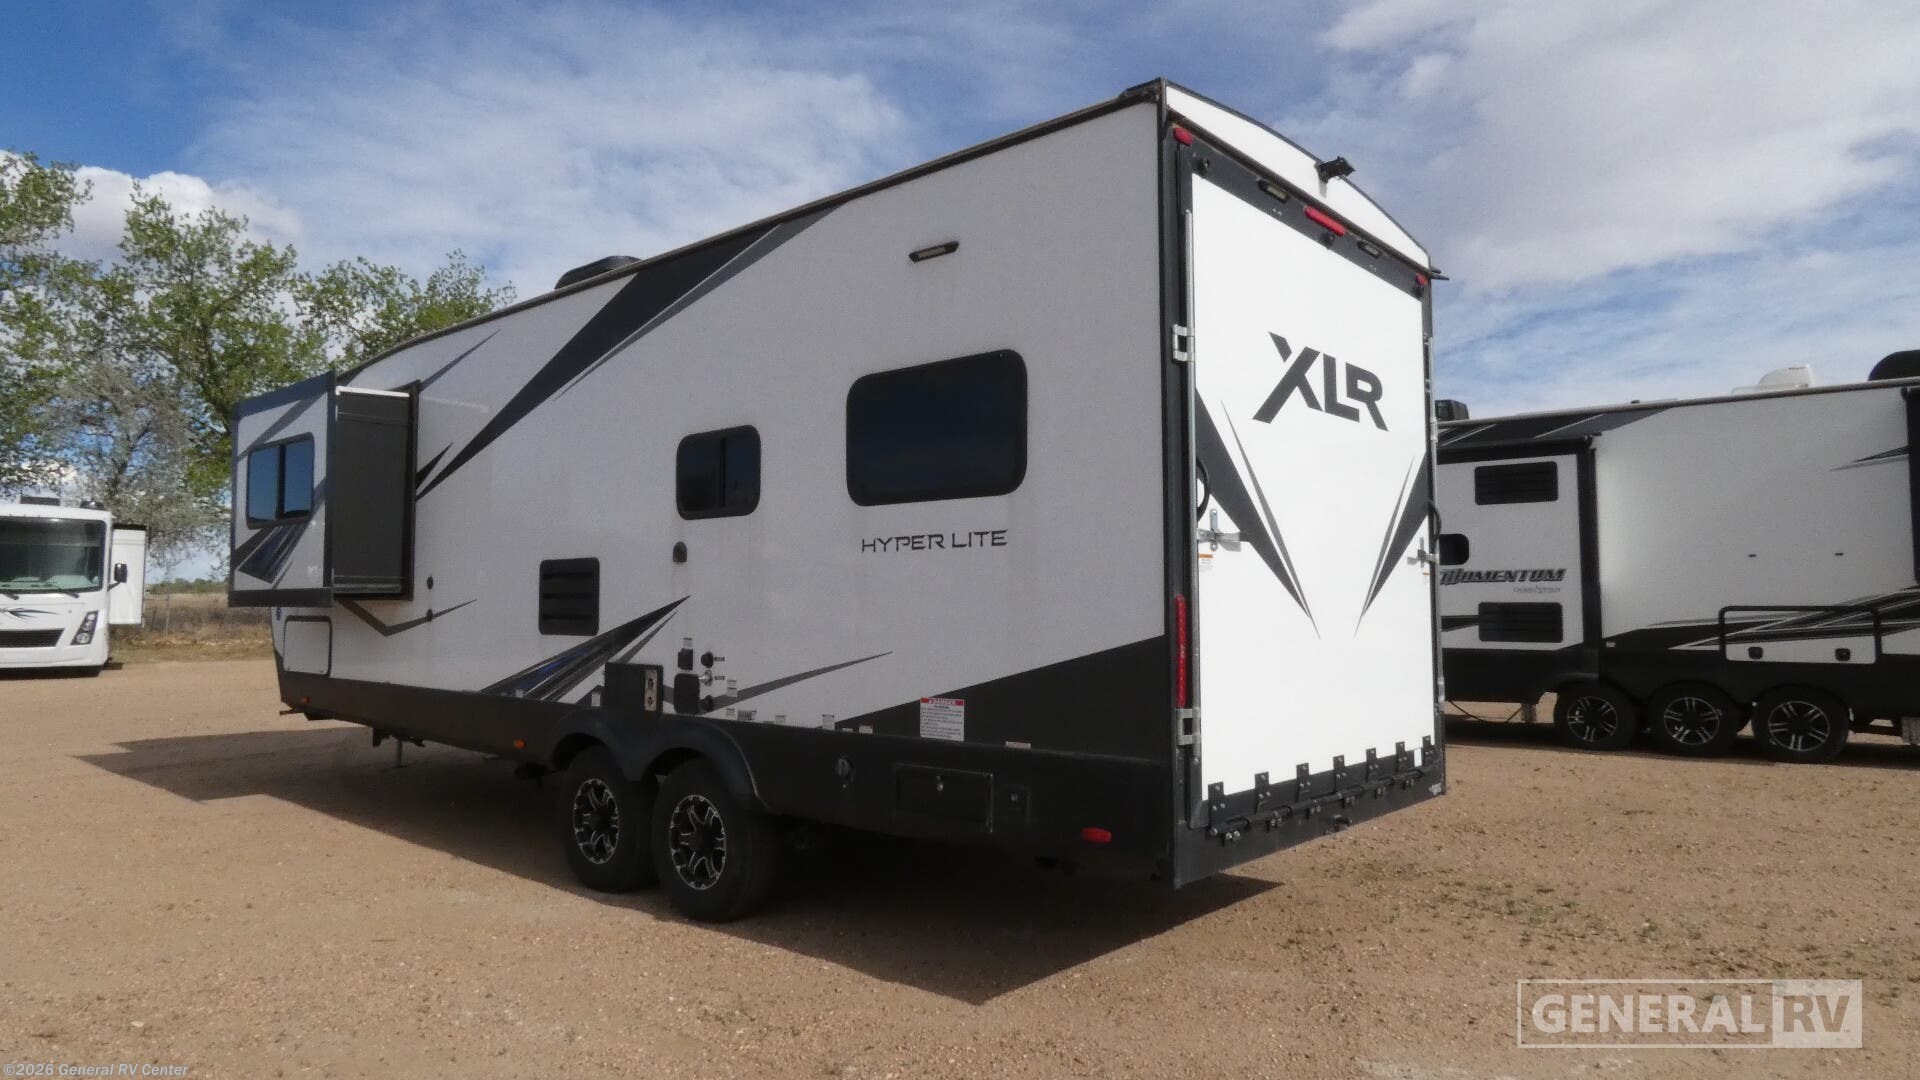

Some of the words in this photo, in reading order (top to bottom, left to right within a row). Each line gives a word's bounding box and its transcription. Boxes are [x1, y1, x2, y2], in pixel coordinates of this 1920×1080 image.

[1252, 331, 1389, 432] XLR
[861, 534, 945, 553] HYPER
[951, 529, 1008, 548] LITE
[1440, 568, 1567, 586] MOMENTUM
